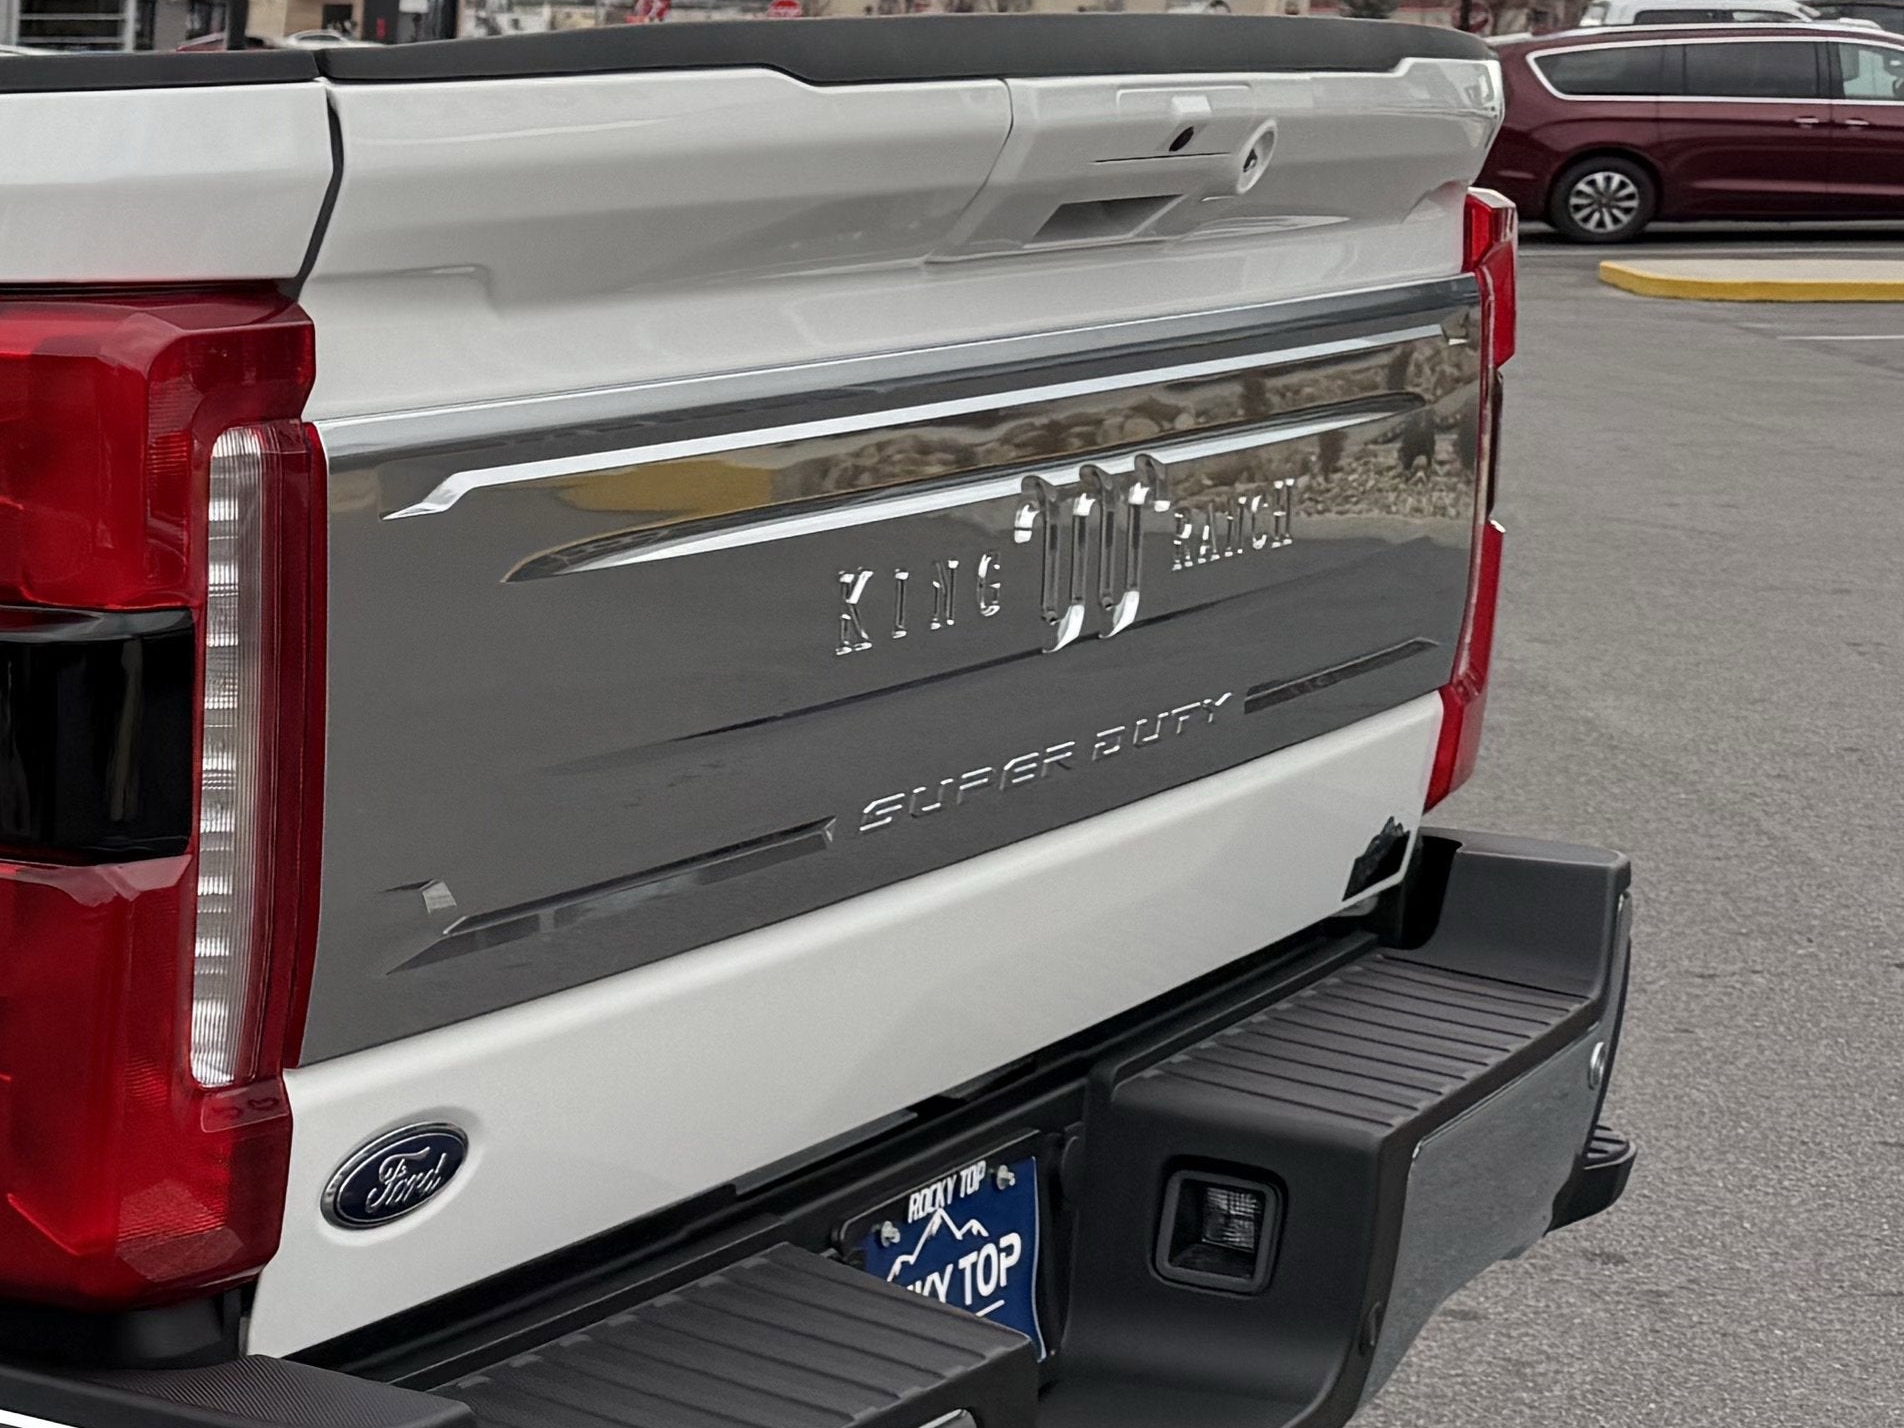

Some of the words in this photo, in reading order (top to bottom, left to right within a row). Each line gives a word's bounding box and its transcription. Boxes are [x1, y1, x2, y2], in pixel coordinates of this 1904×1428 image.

[835, 550, 1002, 656] KING
[858, 740, 1077, 833] SUPER
[1091, 690, 1234, 762] DUTY
[364, 1146, 447, 1214] Ford
[907, 1174, 958, 1224] ROCKY
[960, 1160, 987, 1199] TOP
[958, 1232, 1022, 1305] TOP
